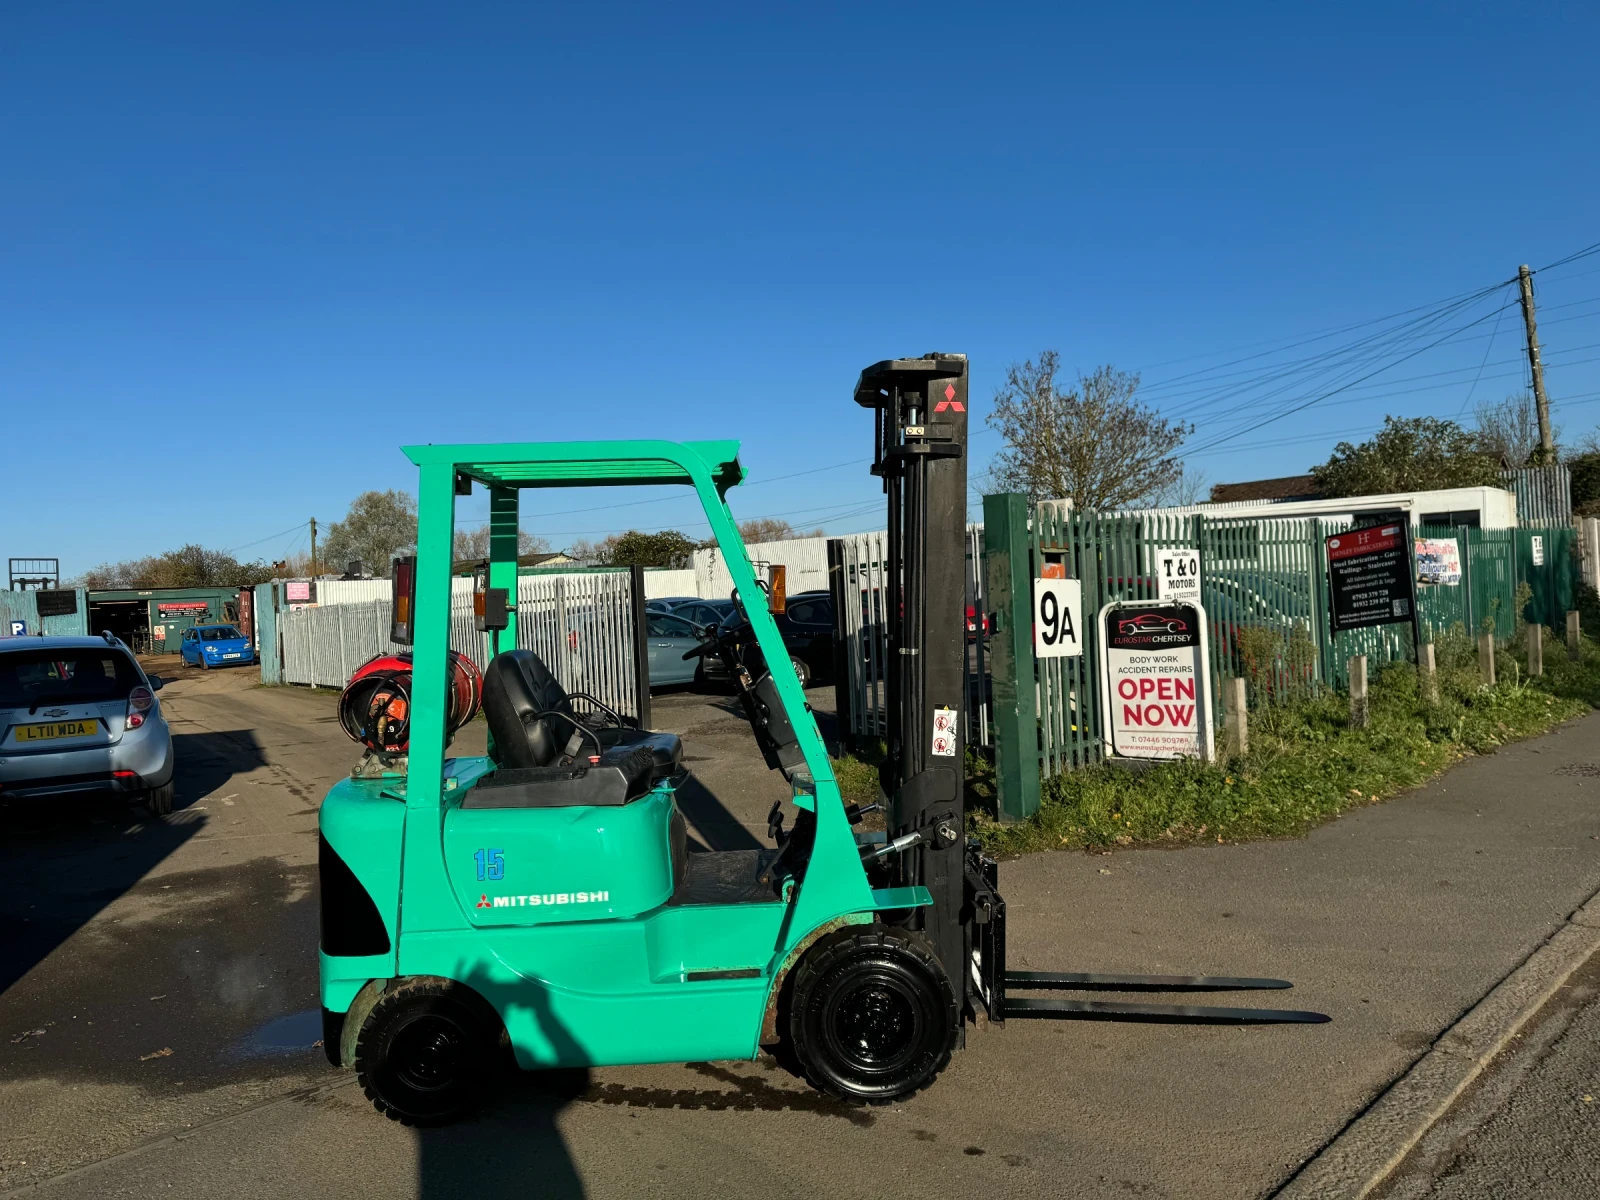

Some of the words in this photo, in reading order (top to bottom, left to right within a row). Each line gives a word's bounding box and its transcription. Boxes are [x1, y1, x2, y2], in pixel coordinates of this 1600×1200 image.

[1332, 548, 1352, 557] HENLEY
[1354, 541, 1389, 553] FABRICATION
[1164, 559, 1173, 577] T
[1177, 558, 1186, 577] &
[1190, 558, 1197, 576] O
[1334, 560, 1346, 568] Steel
[1348, 556, 1378, 565] fabrication
[1340, 566, 1362, 574] Railings
[1368, 560, 1396, 570] Staircases
[1168, 579, 1195, 589] MOTORS
[1040, 590, 1076, 646] 9A
[11, 623, 23, 635] P
[1115, 636, 1151, 644] EUROSTAR
[1152, 634, 1192, 643] CHERTSEY
[1130, 656, 1151, 664] BODY
[1118, 666, 1157, 674] ACCIDENT
[1159, 665, 1193, 673] REPAIRS
[1118, 677, 1195, 701] OPEN
[1123, 704, 1195, 727] NOW
[27, 726, 54, 739] LT11
[57, 723, 85, 737] WDA
[473, 848, 504, 881] 15
[493, 891, 609, 908] MITSUBISHI
